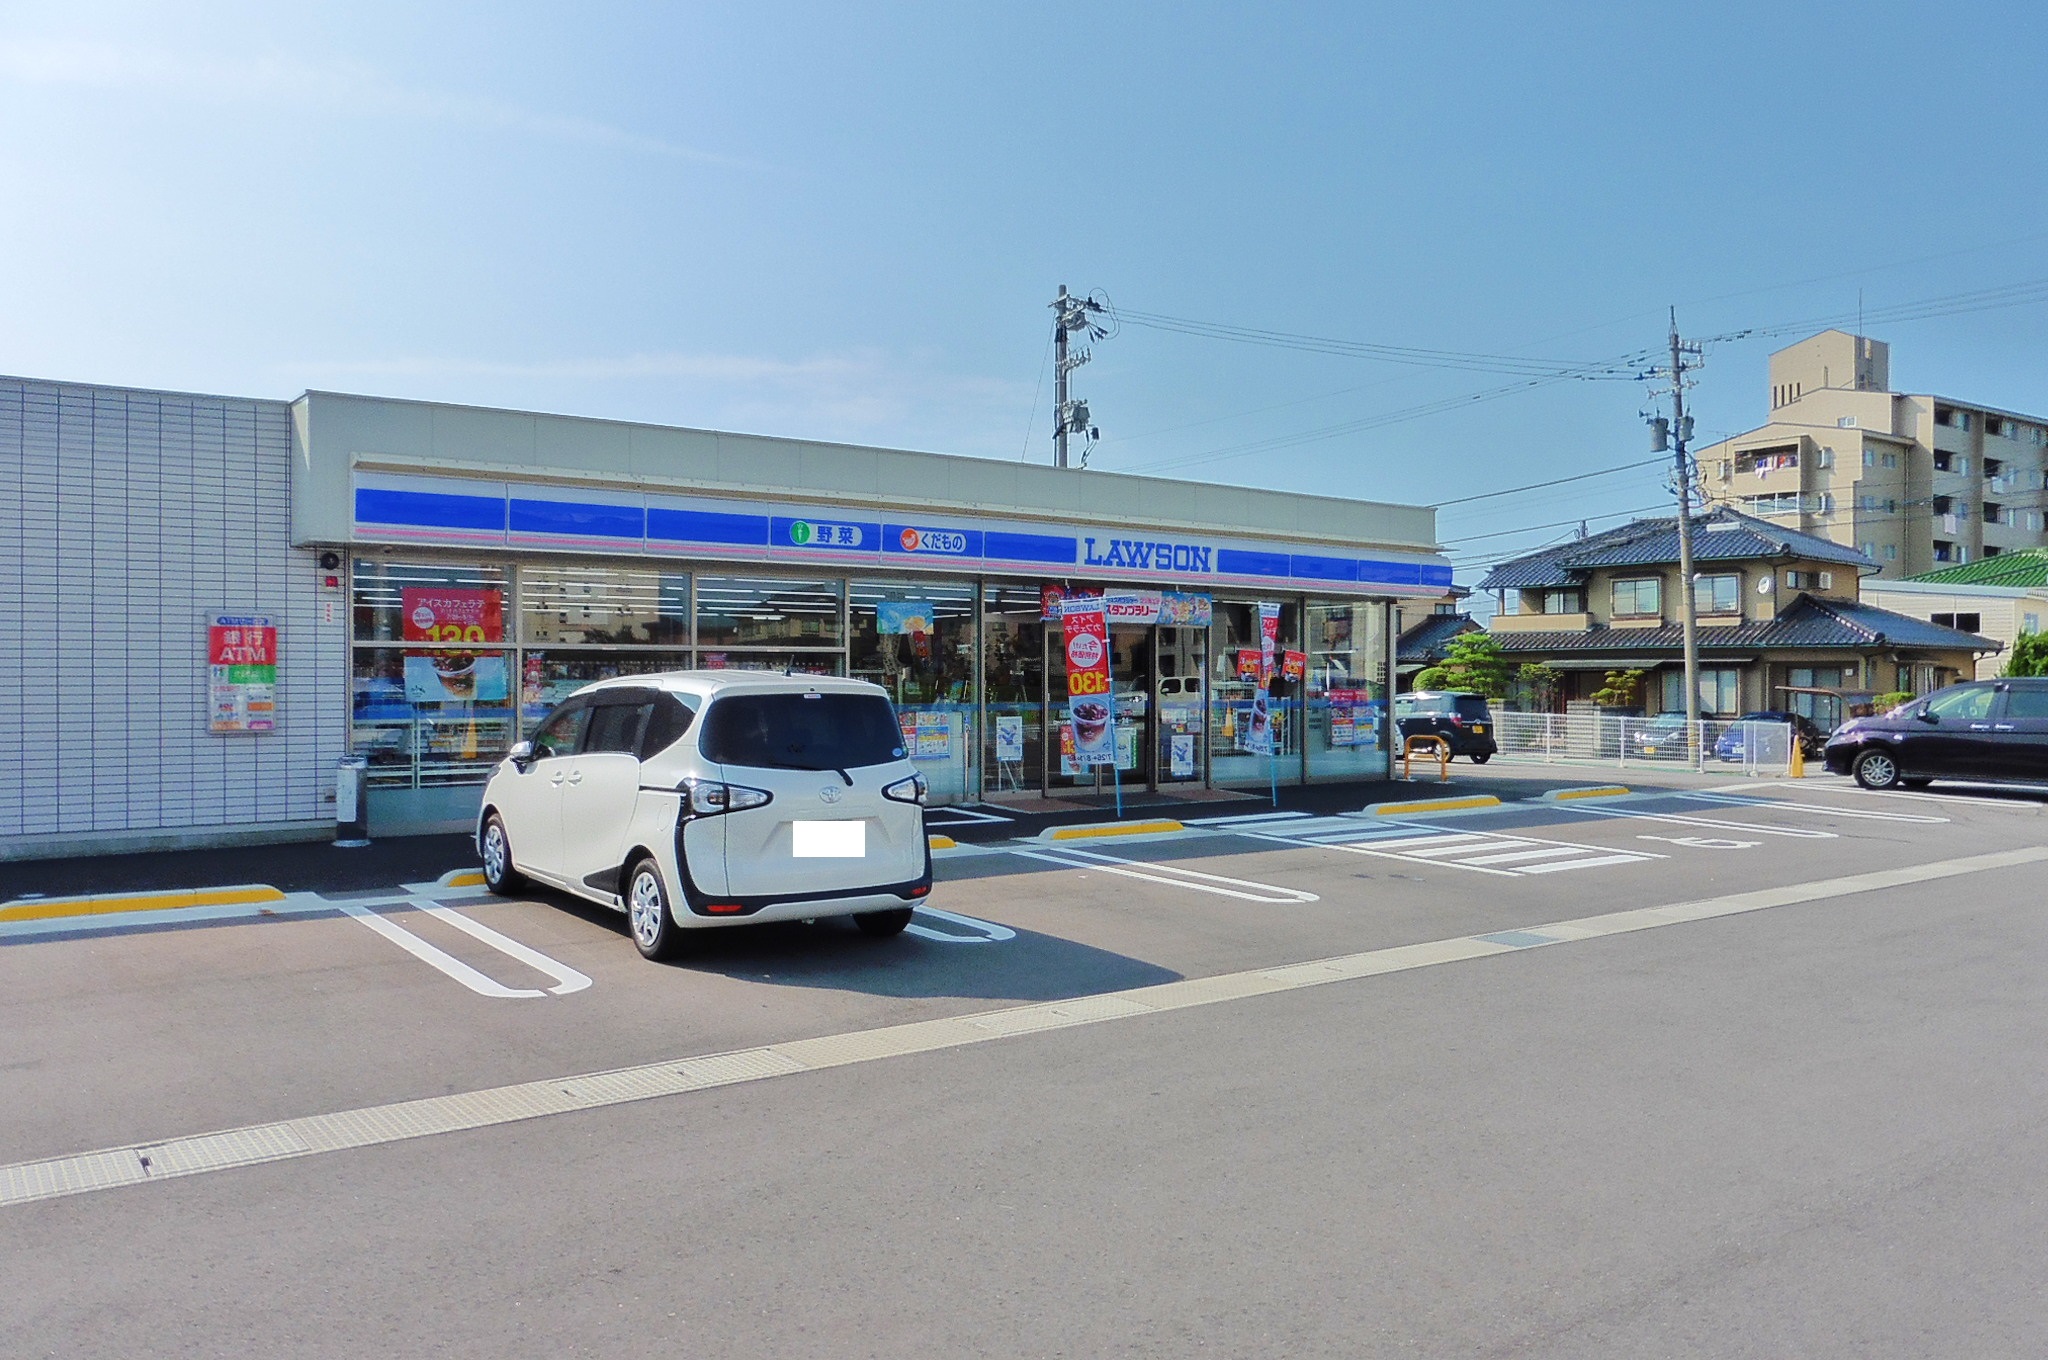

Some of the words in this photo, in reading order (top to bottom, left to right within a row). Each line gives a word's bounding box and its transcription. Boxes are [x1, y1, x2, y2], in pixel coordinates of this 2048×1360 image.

[817, 526, 854, 544] 野菜
[921, 533, 963, 551] くだもの
[1084, 537, 1212, 573] LAWSON
[417, 597, 486, 608] アイスカフェラテ
[219, 647, 266, 662] ATM
